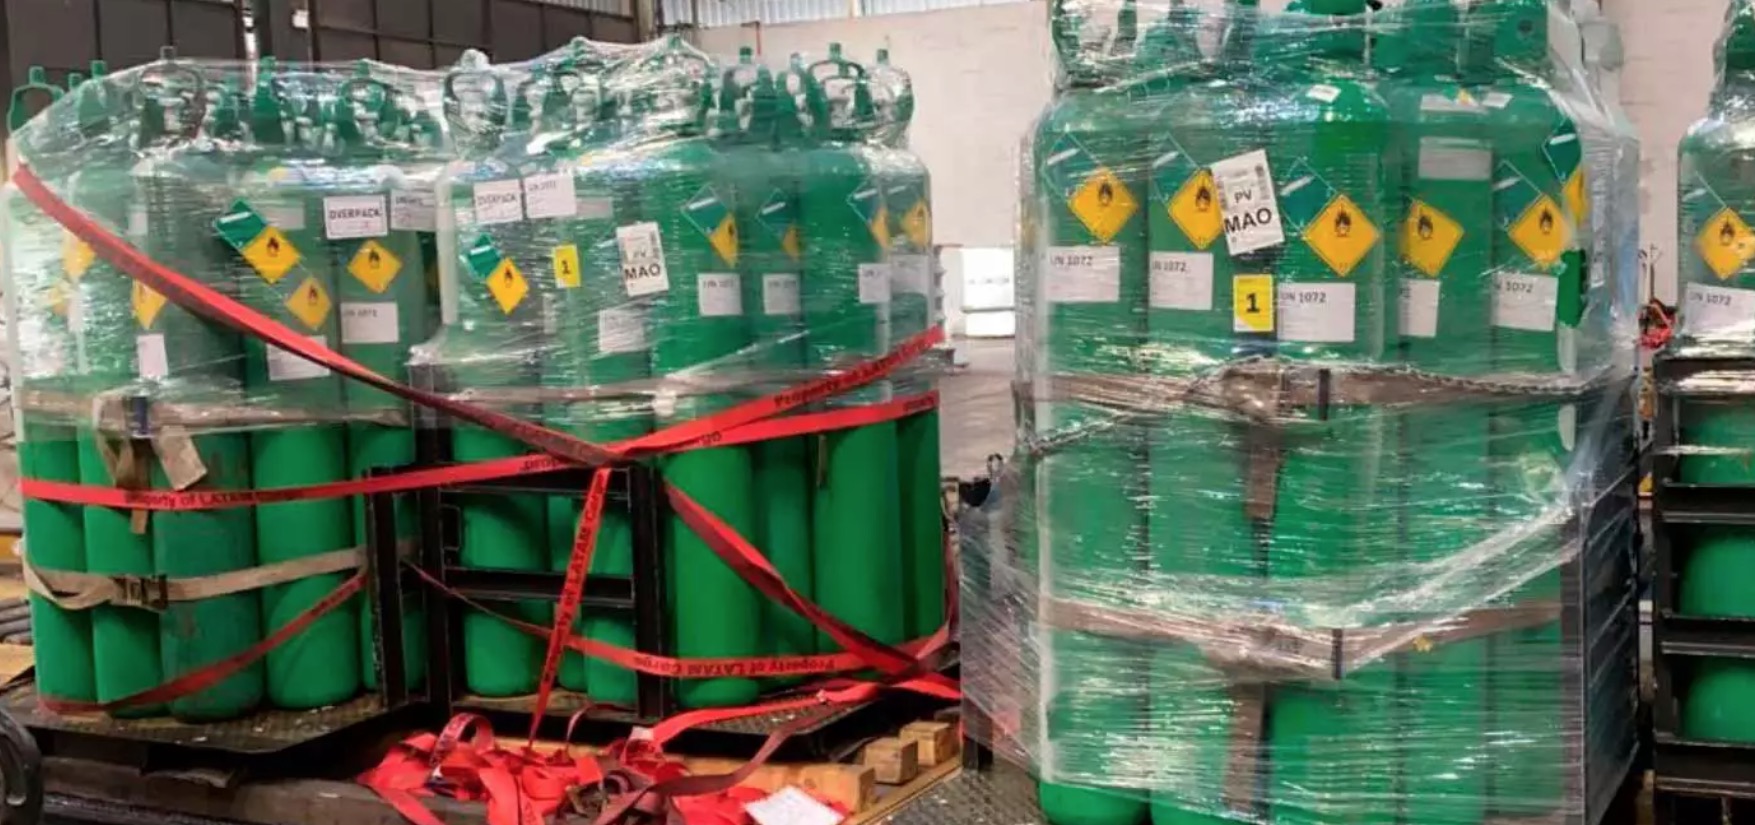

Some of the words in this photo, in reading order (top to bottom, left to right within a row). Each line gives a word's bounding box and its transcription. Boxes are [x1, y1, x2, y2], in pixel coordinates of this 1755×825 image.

[1234, 189, 1252, 203] PV
[328, 208, 382, 219] OVERPACK
[1224, 207, 1272, 234] MAO
[561, 260, 571, 275] 1
[1067, 255, 1093, 267] 1072
[1164, 260, 1187, 272] 1072
[624, 263, 661, 280] MAO
[1506, 281, 1533, 293] 1072
[1246, 292, 1260, 313] 1
[1298, 291, 1327, 304] 1072
[1706, 293, 1731, 306] 1072
[568, 527, 593, 580] LATAM
[563, 588, 577, 606] of
[687, 661, 745, 677] LATAM
[752, 660, 765, 674] of
[771, 658, 836, 677] Property
